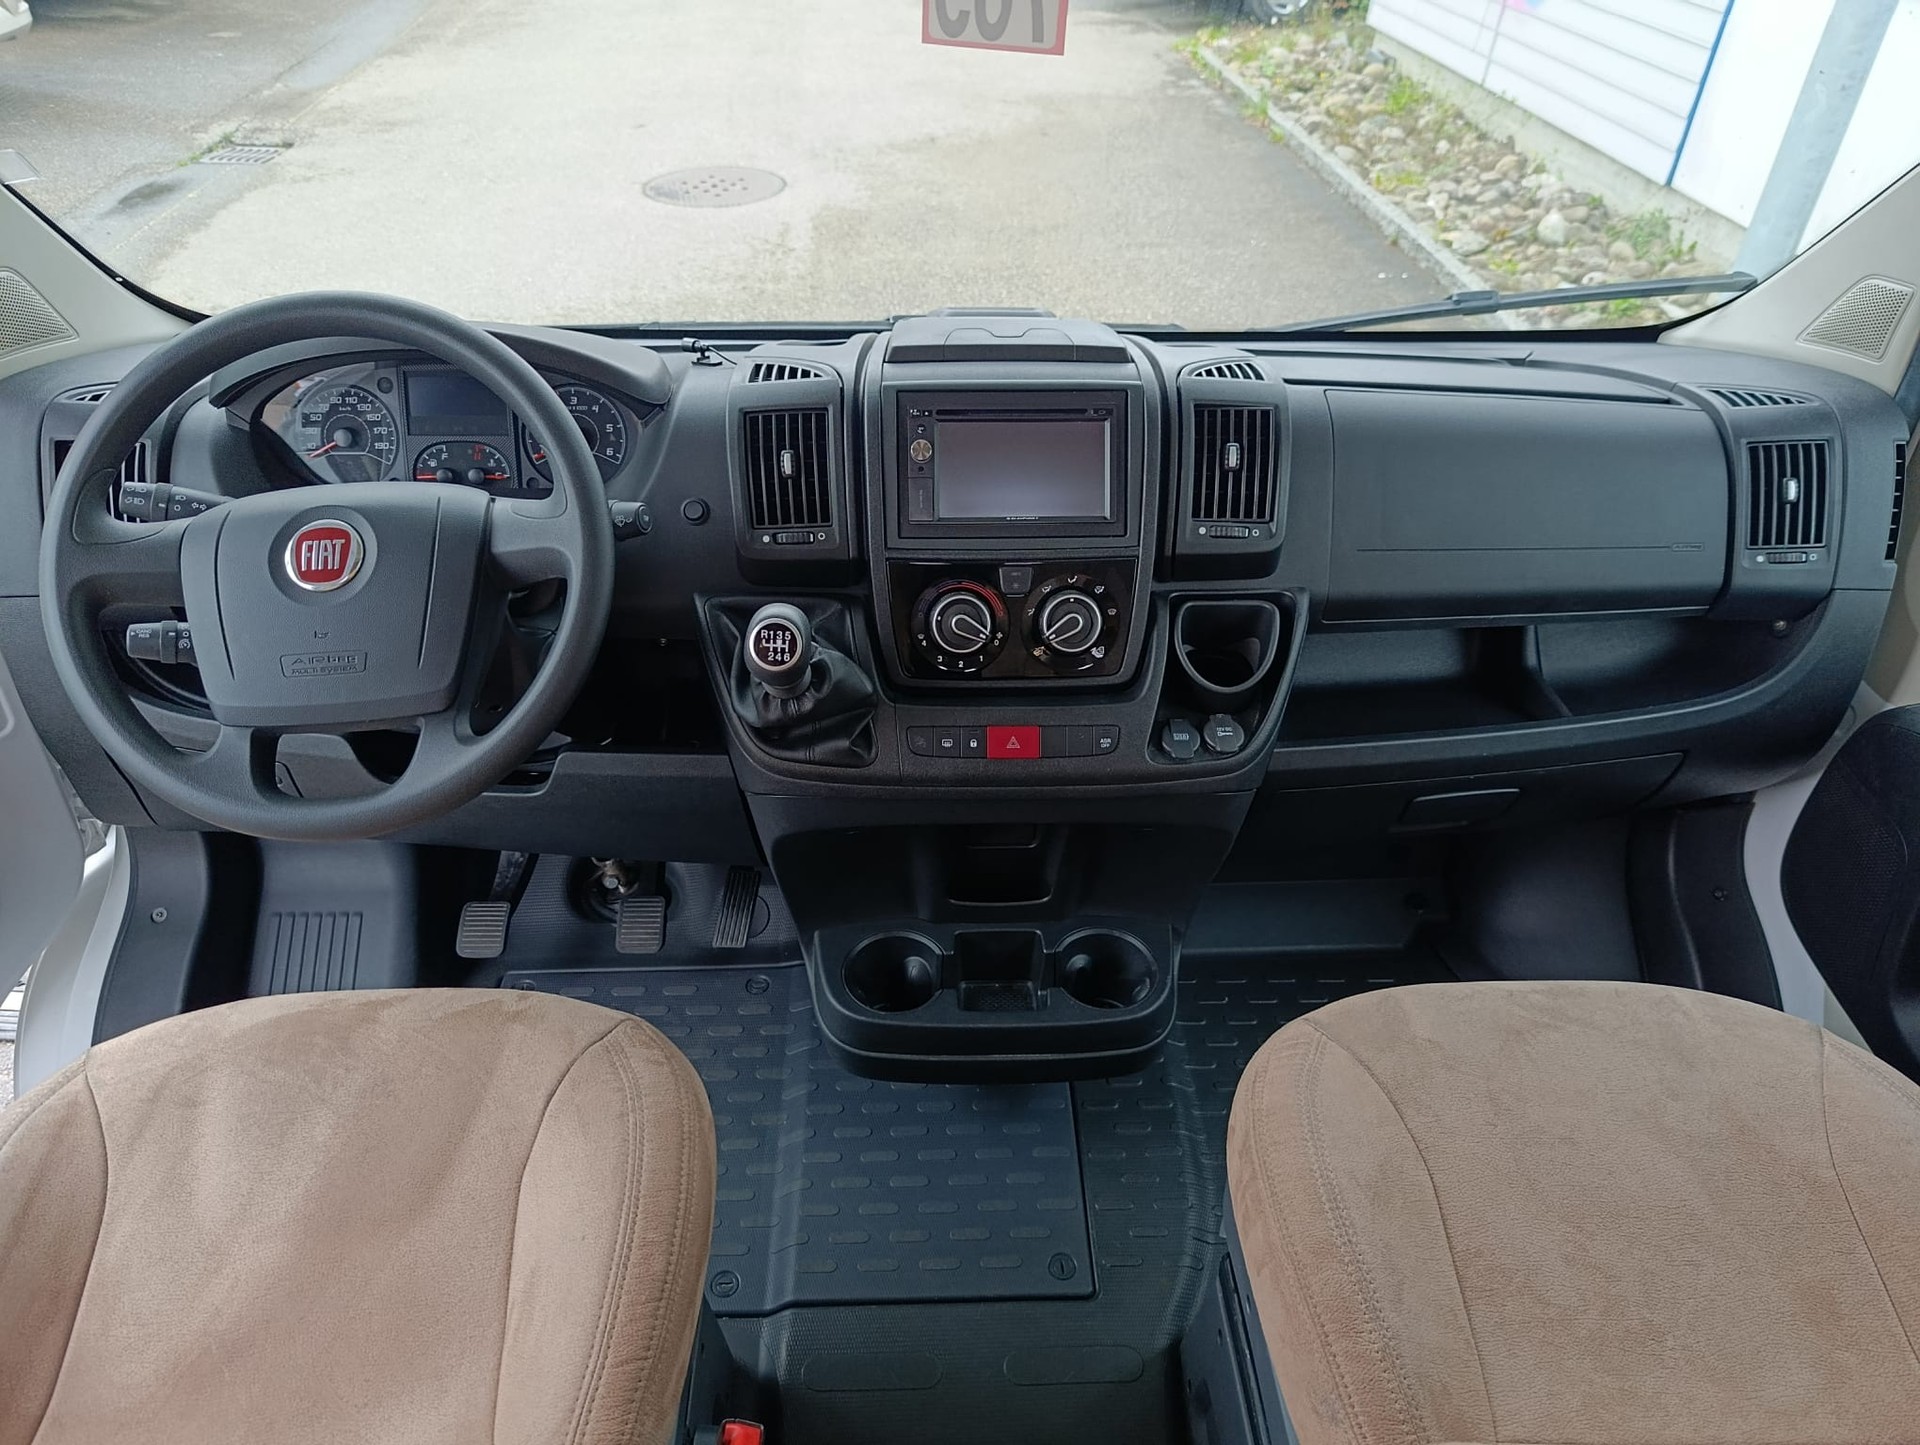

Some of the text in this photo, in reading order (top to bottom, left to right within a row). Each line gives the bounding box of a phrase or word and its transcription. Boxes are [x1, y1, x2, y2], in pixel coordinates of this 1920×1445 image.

[344, 396, 358, 404] 110
[569, 396, 578, 405] 3
[319, 403, 330, 411] 70
[356, 403, 372, 411] 130
[591, 404, 599, 413] 4
[310, 413, 322, 421] 50
[366, 413, 381, 421] 150
[373, 427, 388, 435] 170
[605, 423, 614, 433] 5
[307, 442, 316, 450] 10
[374, 442, 390, 450] 190
[606, 447, 614, 456] 6
[441, 452, 449, 460] F
[301, 539, 345, 571] FIAT
[761, 629, 791, 640] R 1 3 5
[768, 652, 790, 662] 2 4 6
[958, 660, 964, 668] 2
